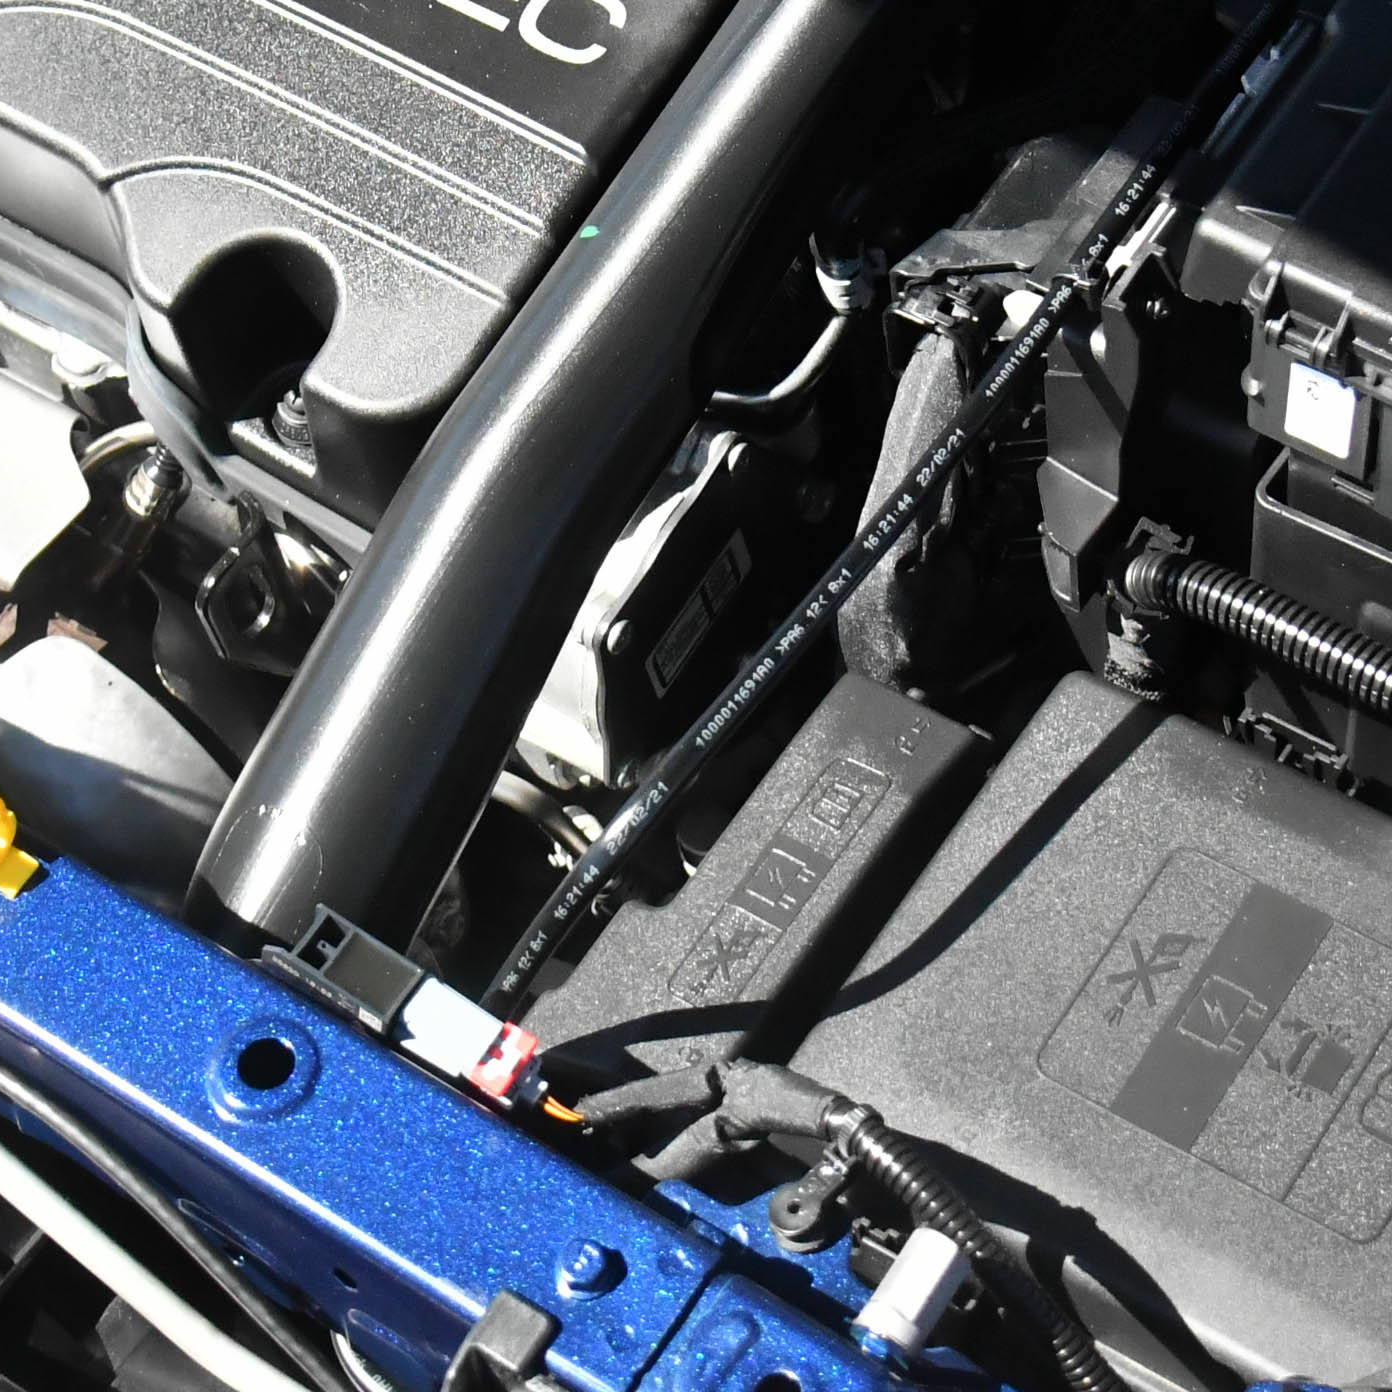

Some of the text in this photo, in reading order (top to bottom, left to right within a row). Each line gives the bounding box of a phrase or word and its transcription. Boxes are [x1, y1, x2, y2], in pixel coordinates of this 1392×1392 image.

[554, 864, 601, 921] 16:21:44
[826, 567, 852, 595] 8x1
[862, 492, 914, 552] 16:21:44
[915, 427, 966, 488] 22/02/21
[1113, 163, 1157, 217] 16:21:44
